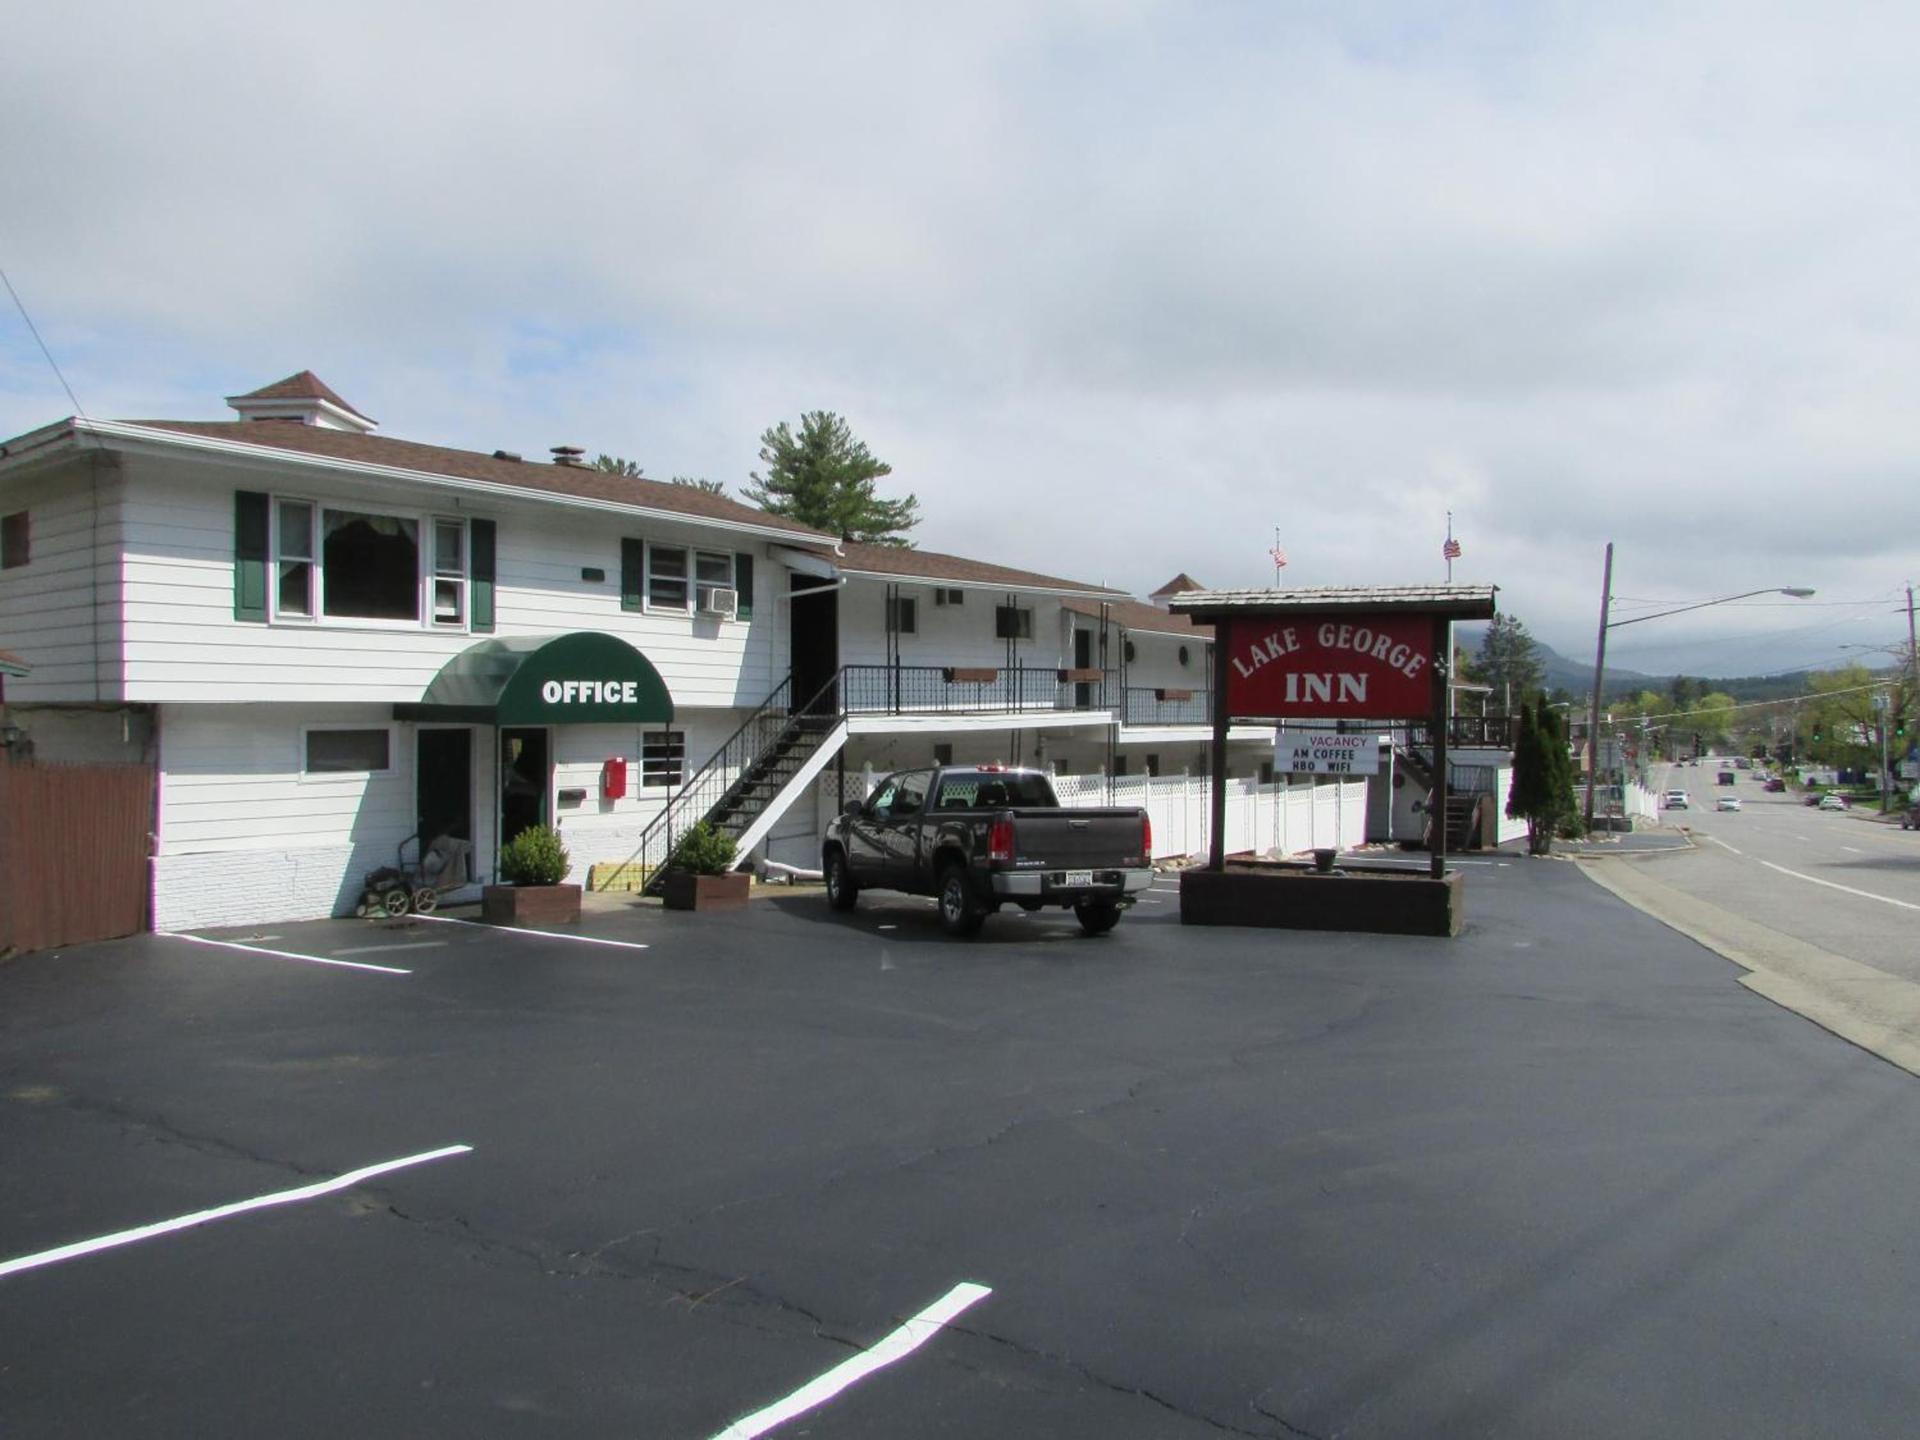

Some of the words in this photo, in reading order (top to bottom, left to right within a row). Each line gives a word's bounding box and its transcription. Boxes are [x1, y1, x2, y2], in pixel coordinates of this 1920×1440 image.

[1232, 627, 1300, 679] LAKE
[1318, 623, 1427, 679] GEORGE
[542, 681, 638, 704] OFFICE
[1284, 673, 1369, 703] INN
[1310, 736, 1367, 747] VACANCY
[1293, 748, 1309, 758] AM
[1313, 749, 1355, 760] COFFEE
[1292, 761, 1316, 772] HBO
[1327, 762, 1351, 772] WIFI
